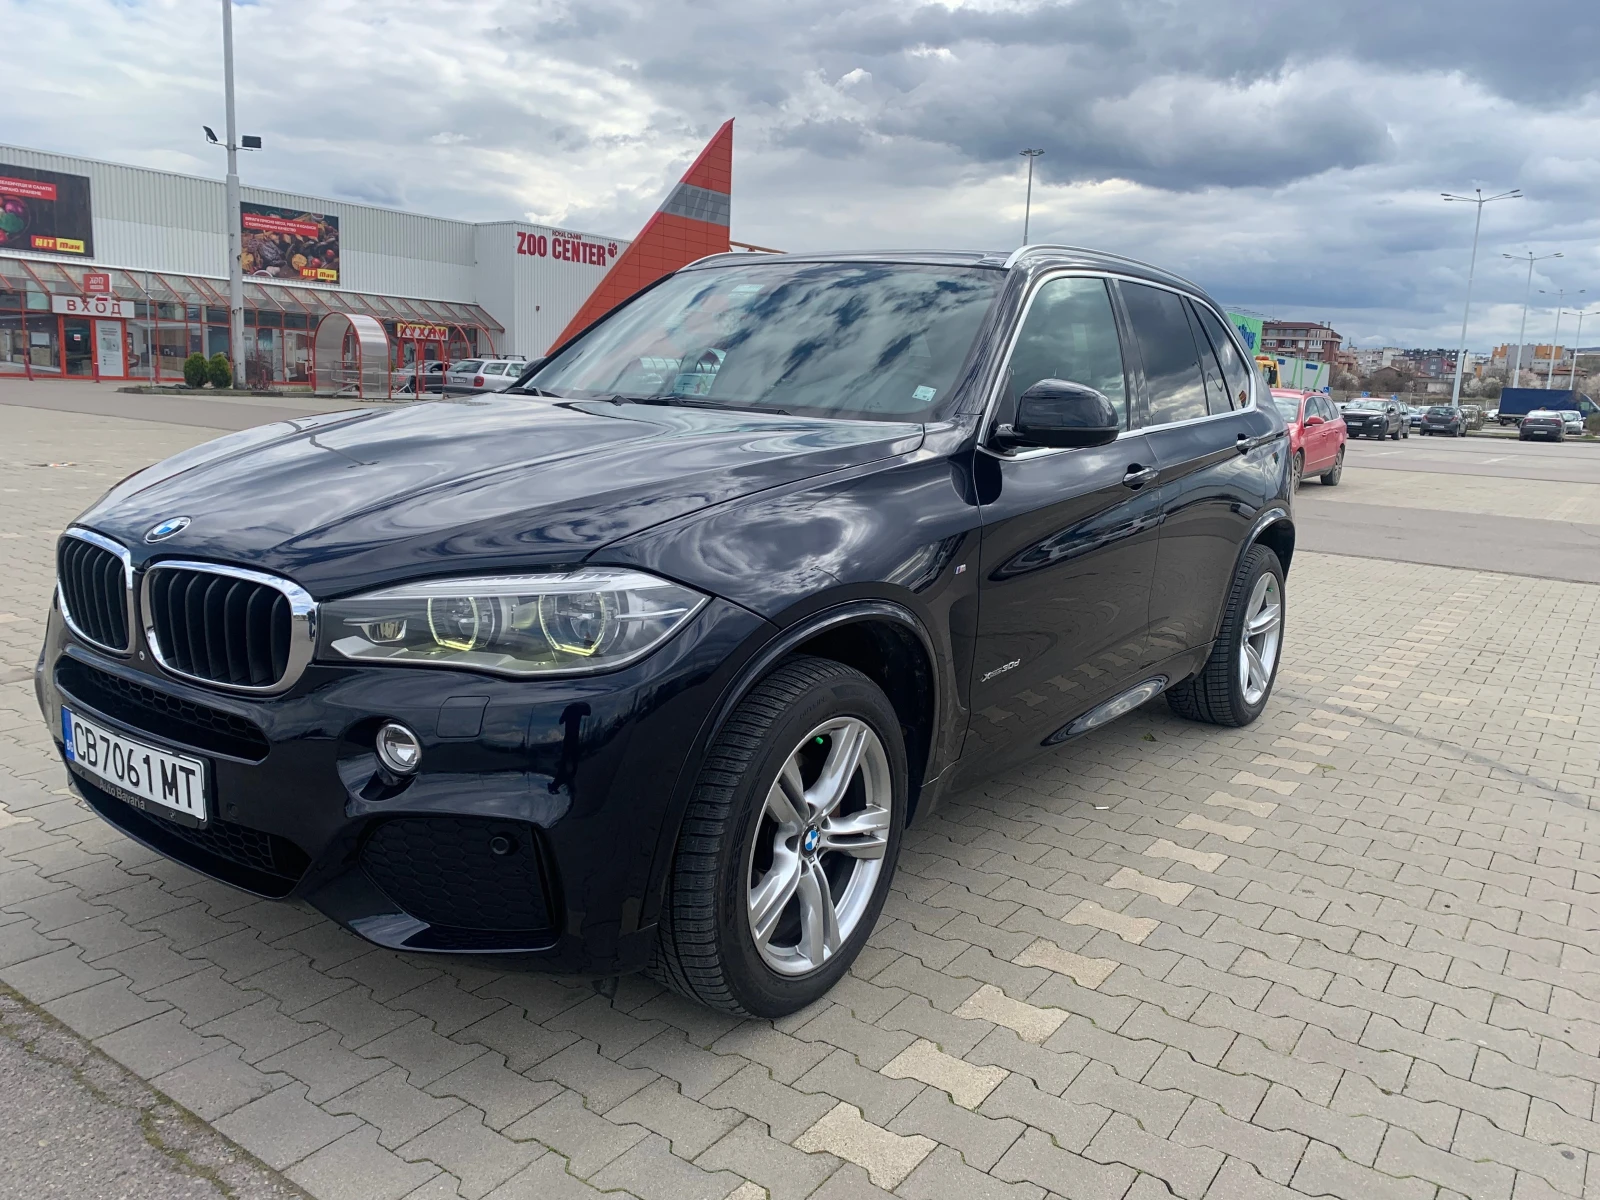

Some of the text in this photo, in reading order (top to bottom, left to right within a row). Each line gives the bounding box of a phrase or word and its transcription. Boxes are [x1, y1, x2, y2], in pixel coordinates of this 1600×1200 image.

[35, 238, 55, 248] HIT
[517, 231, 606, 267] ZOO CENTER
[302, 268, 316, 277] HIT
[67, 299, 122, 316] ВХОД
[99, 779, 145, 810] Auto Bavaria
